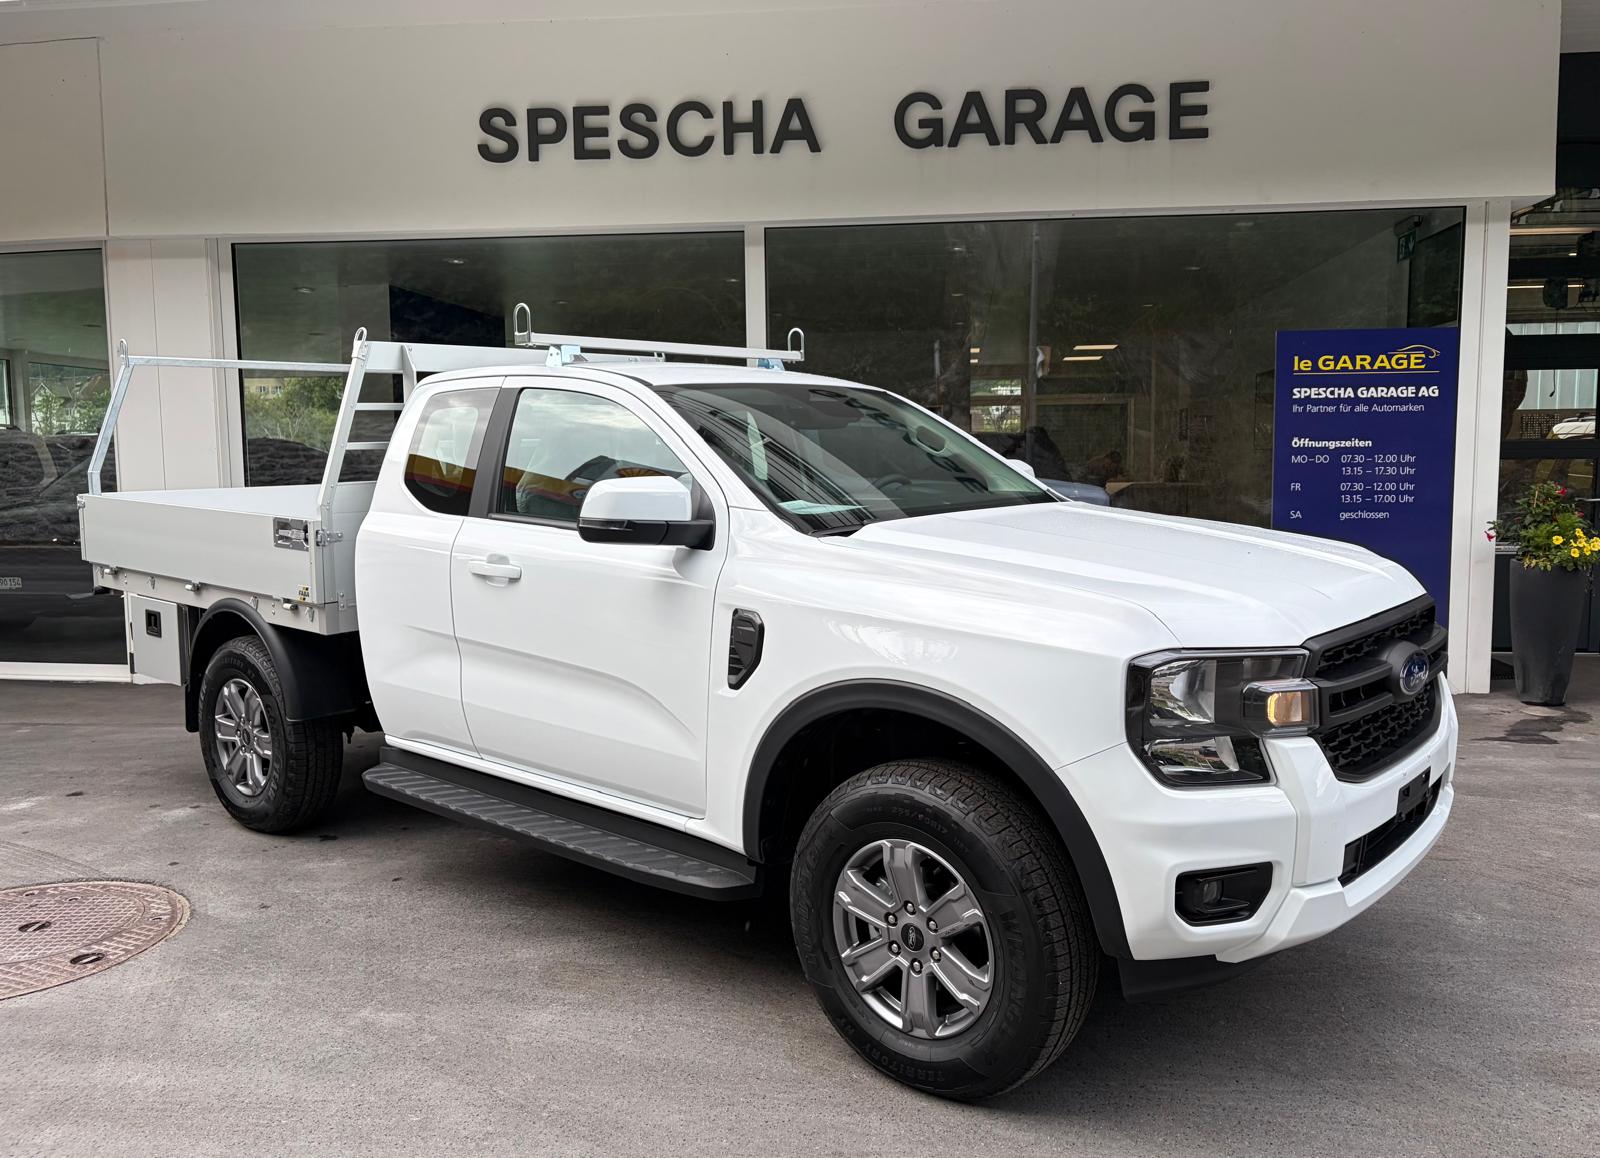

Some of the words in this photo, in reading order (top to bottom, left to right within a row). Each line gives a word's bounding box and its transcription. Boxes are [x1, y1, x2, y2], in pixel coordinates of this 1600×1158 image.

[478, 98, 821, 163] SPESCHA
[894, 81, 1209, 149] GARAGE
[1293, 356, 1312, 370] le
[1318, 354, 1426, 370] GARAGE
[1292, 387, 1355, 399] SPESCHA
[1357, 386, 1416, 398] GARAGE
[1418, 386, 1439, 397] AG
[1292, 404, 1304, 413] Ihr
[1306, 404, 1337, 413] Partner
[1339, 403, 1352, 412] für
[1354, 403, 1369, 412] alle
[1371, 403, 1425, 412] Automarken
[1291, 437, 1372, 450] Öffnungszeiten
[1341, 454, 1365, 463] 07.30
[1374, 454, 1398, 463] 12.00
[1400, 454, 1416, 463] Uhr
[1342, 466, 1363, 476] 13.15
[1374, 466, 1397, 475] 17.30
[1399, 466, 1416, 475] Uhr
[1290, 482, 1301, 491] FR
[1340, 482, 1364, 491] 07.30
[1373, 482, 1397, 491] 12.00
[1399, 482, 1415, 491] Uhr
[1341, 494, 1362, 503] 13.15
[1374, 494, 1396, 503] 17.00
[1398, 494, 1415, 503] Uhr
[1290, 510, 1302, 519] SA
[1339, 510, 1390, 521] geschlossen
